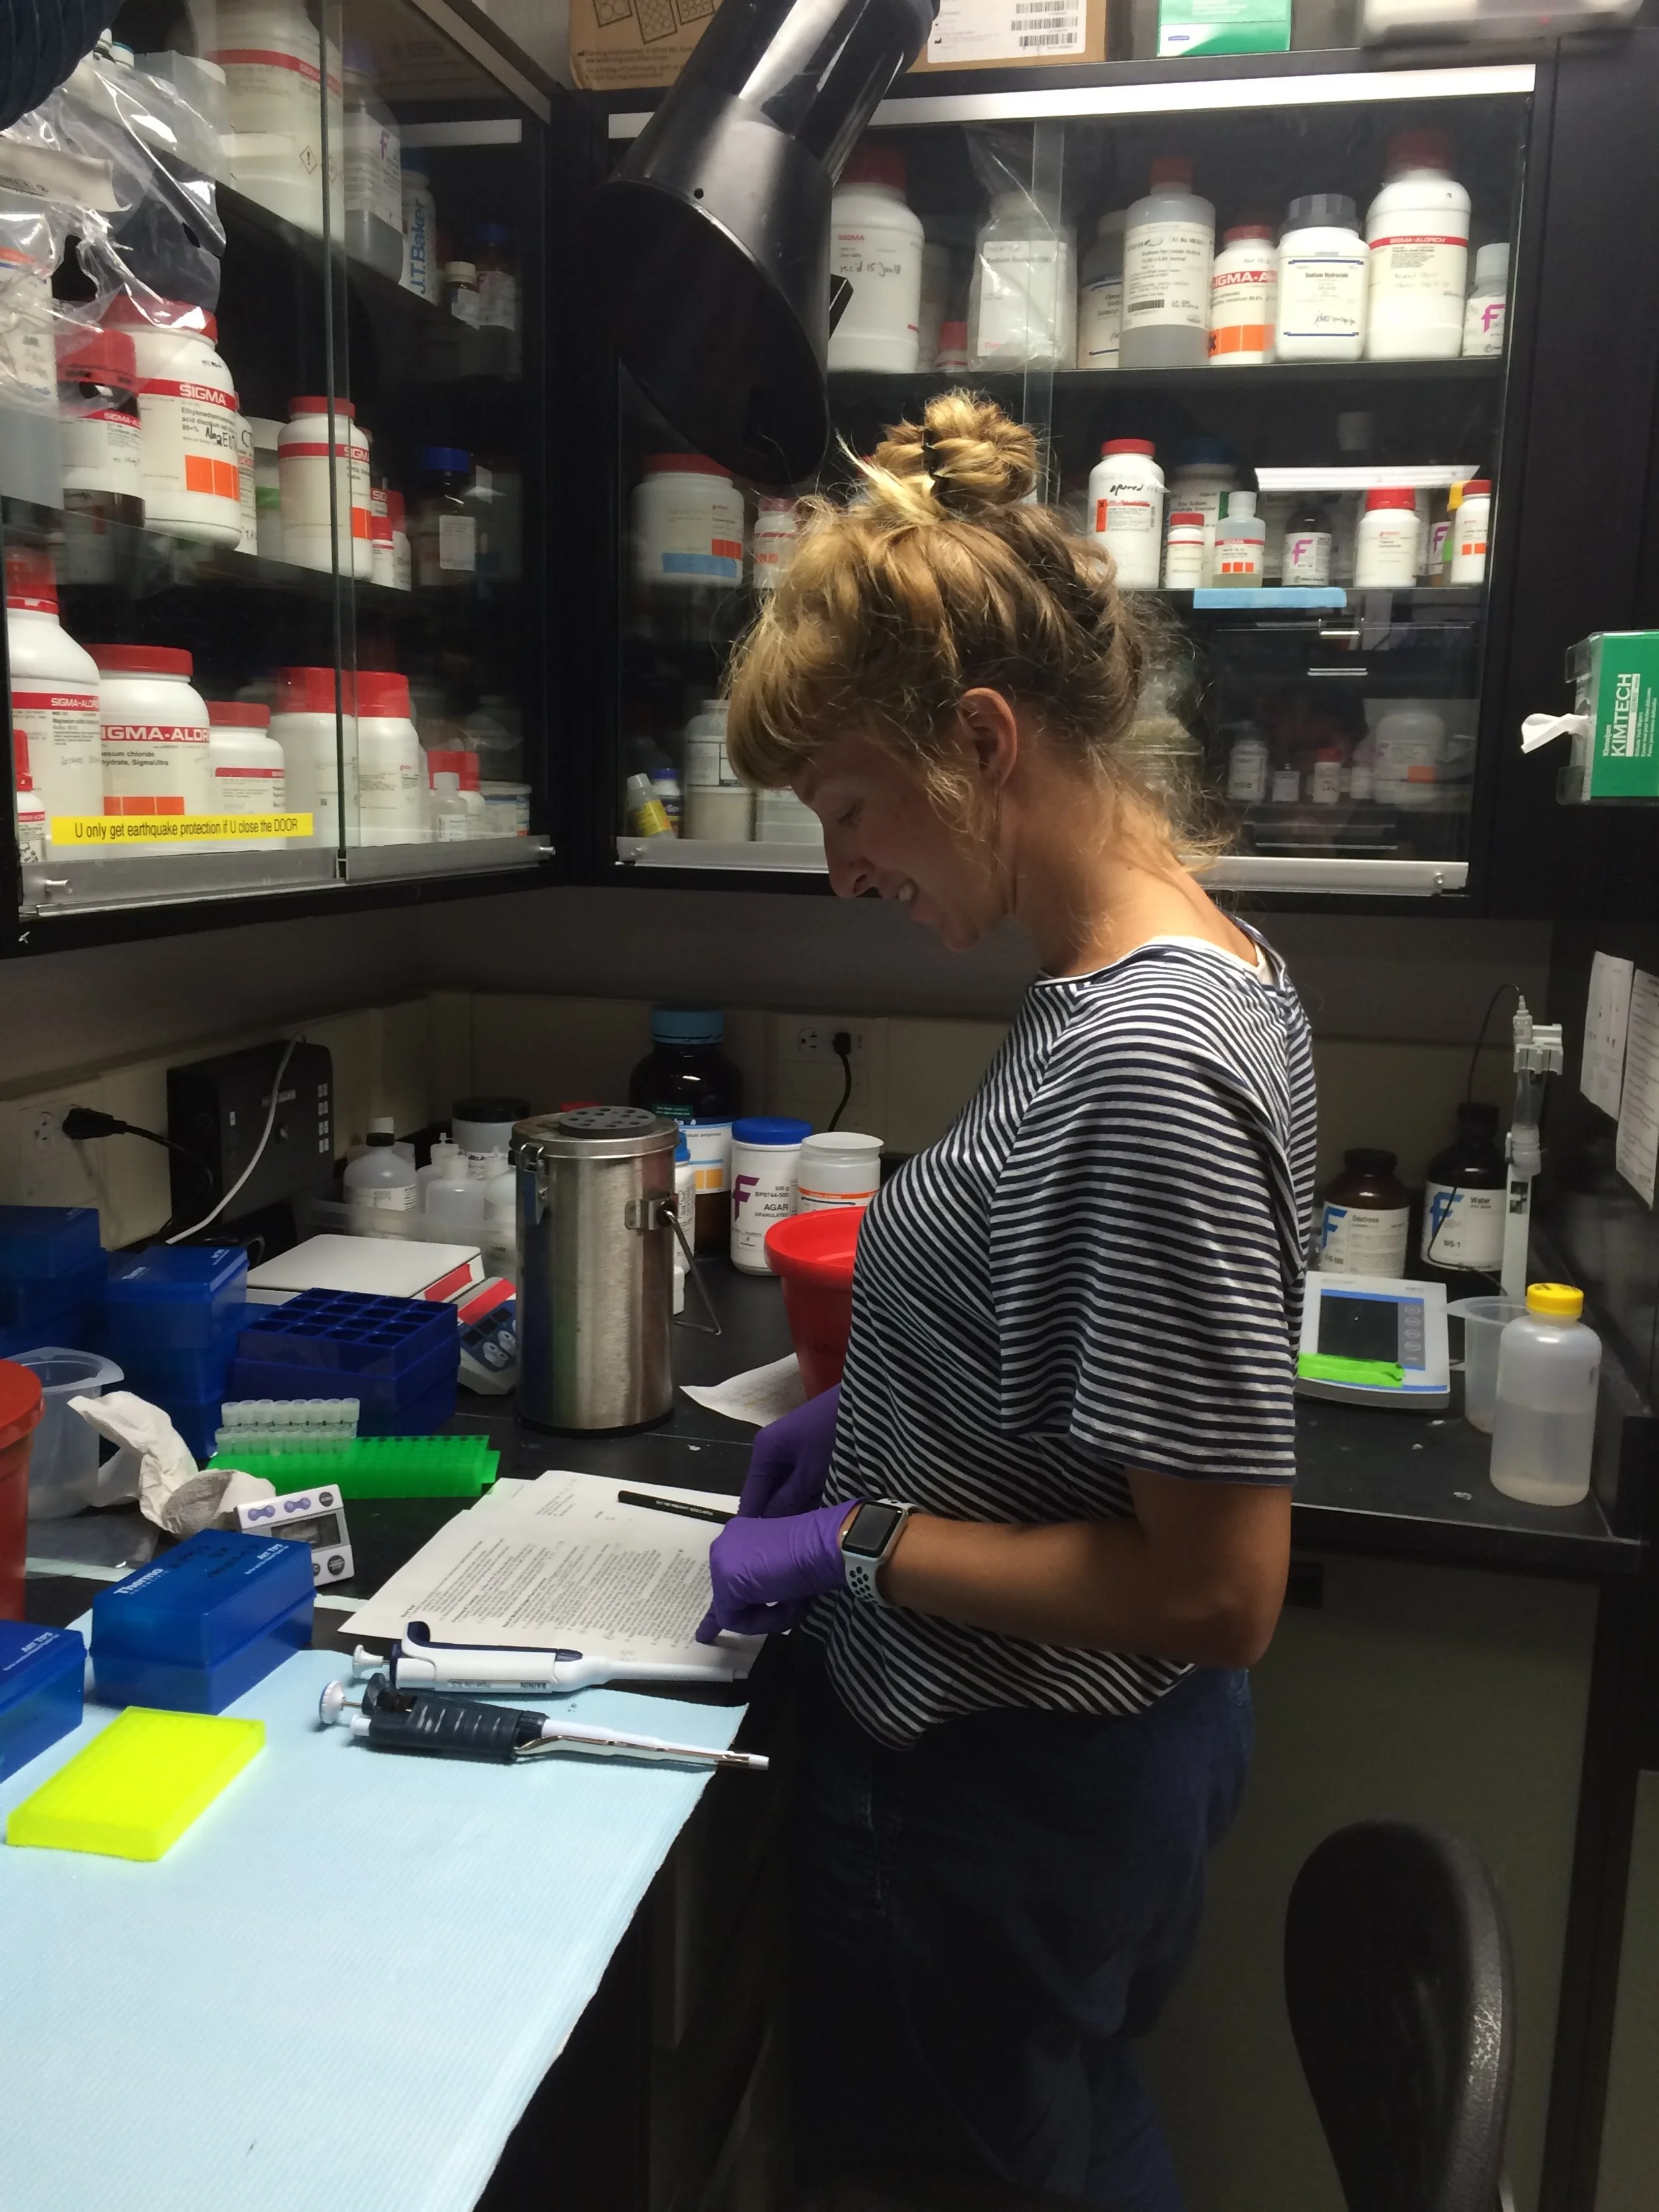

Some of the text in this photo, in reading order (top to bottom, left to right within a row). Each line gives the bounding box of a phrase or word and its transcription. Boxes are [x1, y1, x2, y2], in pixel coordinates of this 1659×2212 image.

[411, 198, 427, 295] J.T.Baker
[1481, 304, 1506, 332] F
[179, 384, 227, 406] SIGMA
[1293, 540, 1314, 566] F
[1611, 674, 1632, 757] KIMTECH
[1603, 724, 1612, 757] Kimwipes
[74, 818, 298, 840] U only get earthquake protection if U close the DOOR
[732, 1174, 760, 1222] F
[1323, 1206, 1348, 1248] F
[1352, 1215, 1380, 1223] Dextrose
[1429, 1191, 1465, 1238] F
[113, 1568, 164, 1595] Thermo
